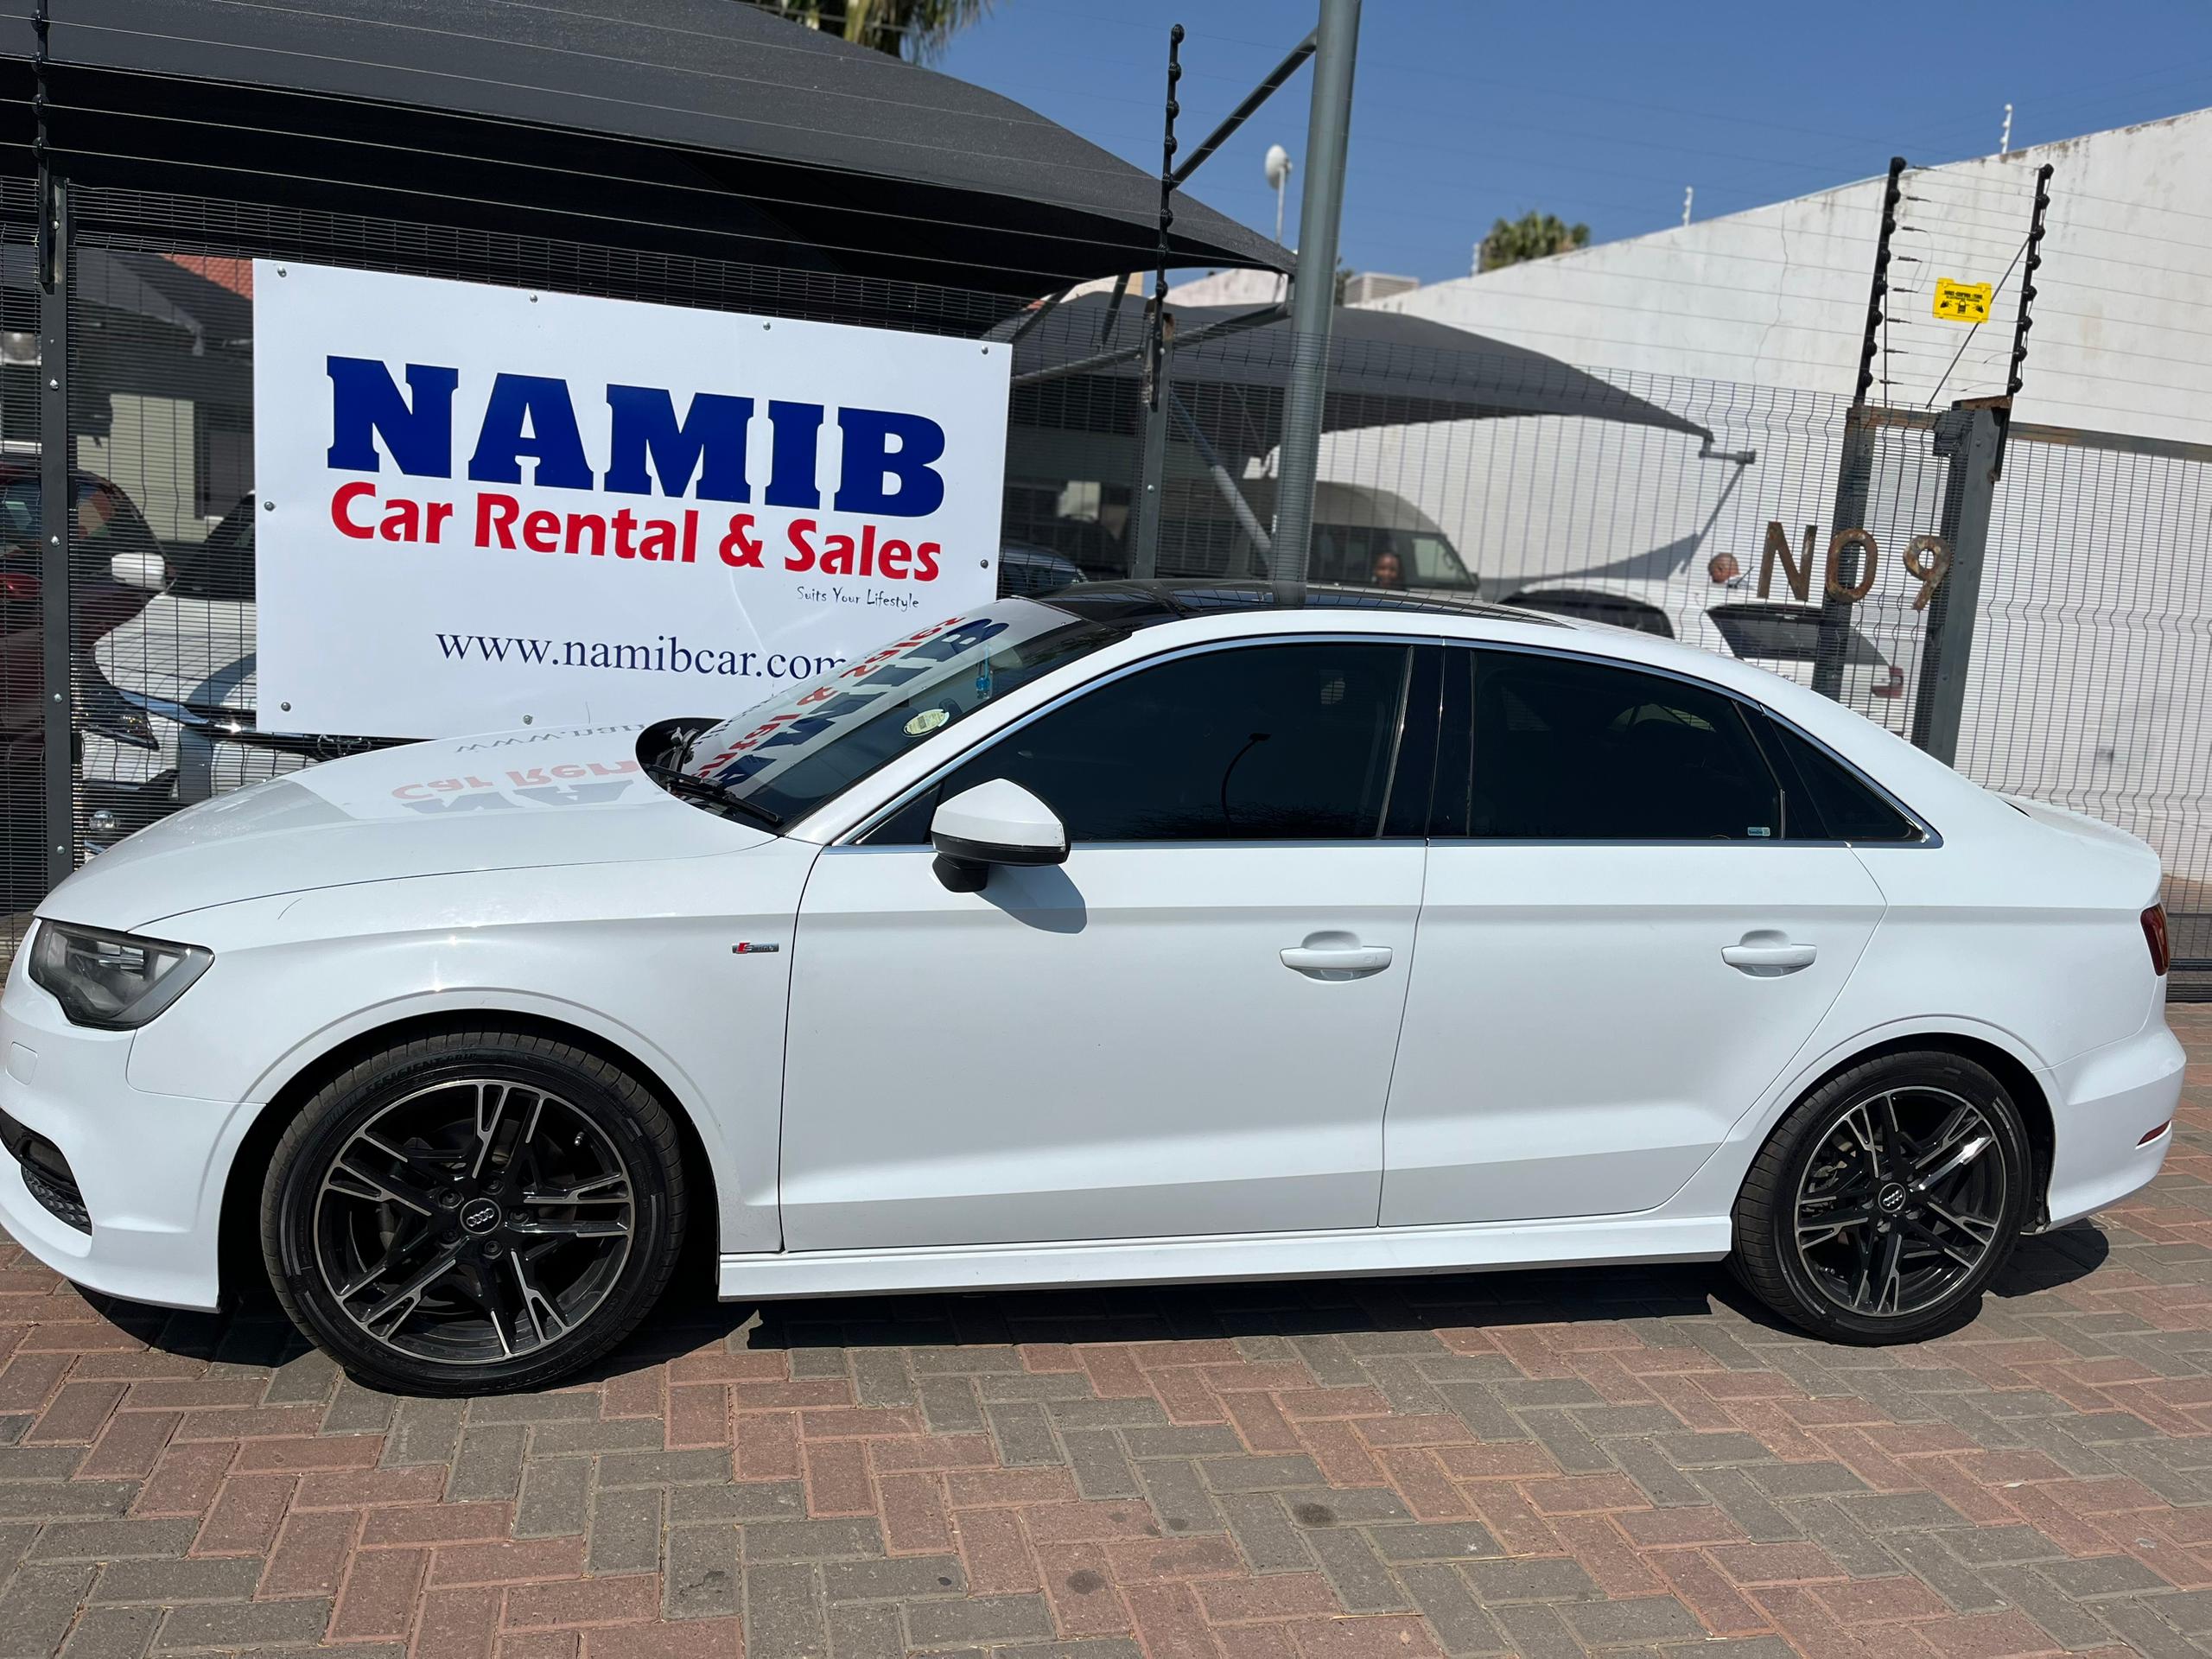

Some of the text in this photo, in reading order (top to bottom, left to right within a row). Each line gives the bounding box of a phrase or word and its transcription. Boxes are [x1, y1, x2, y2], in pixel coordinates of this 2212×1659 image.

[327, 355, 945, 518] NAMIB
[331, 481, 941, 582] Car Rental & Sales
[1903, 535, 1951, 610] 9
[797, 586, 919, 612] Suits Your Lifestyle
